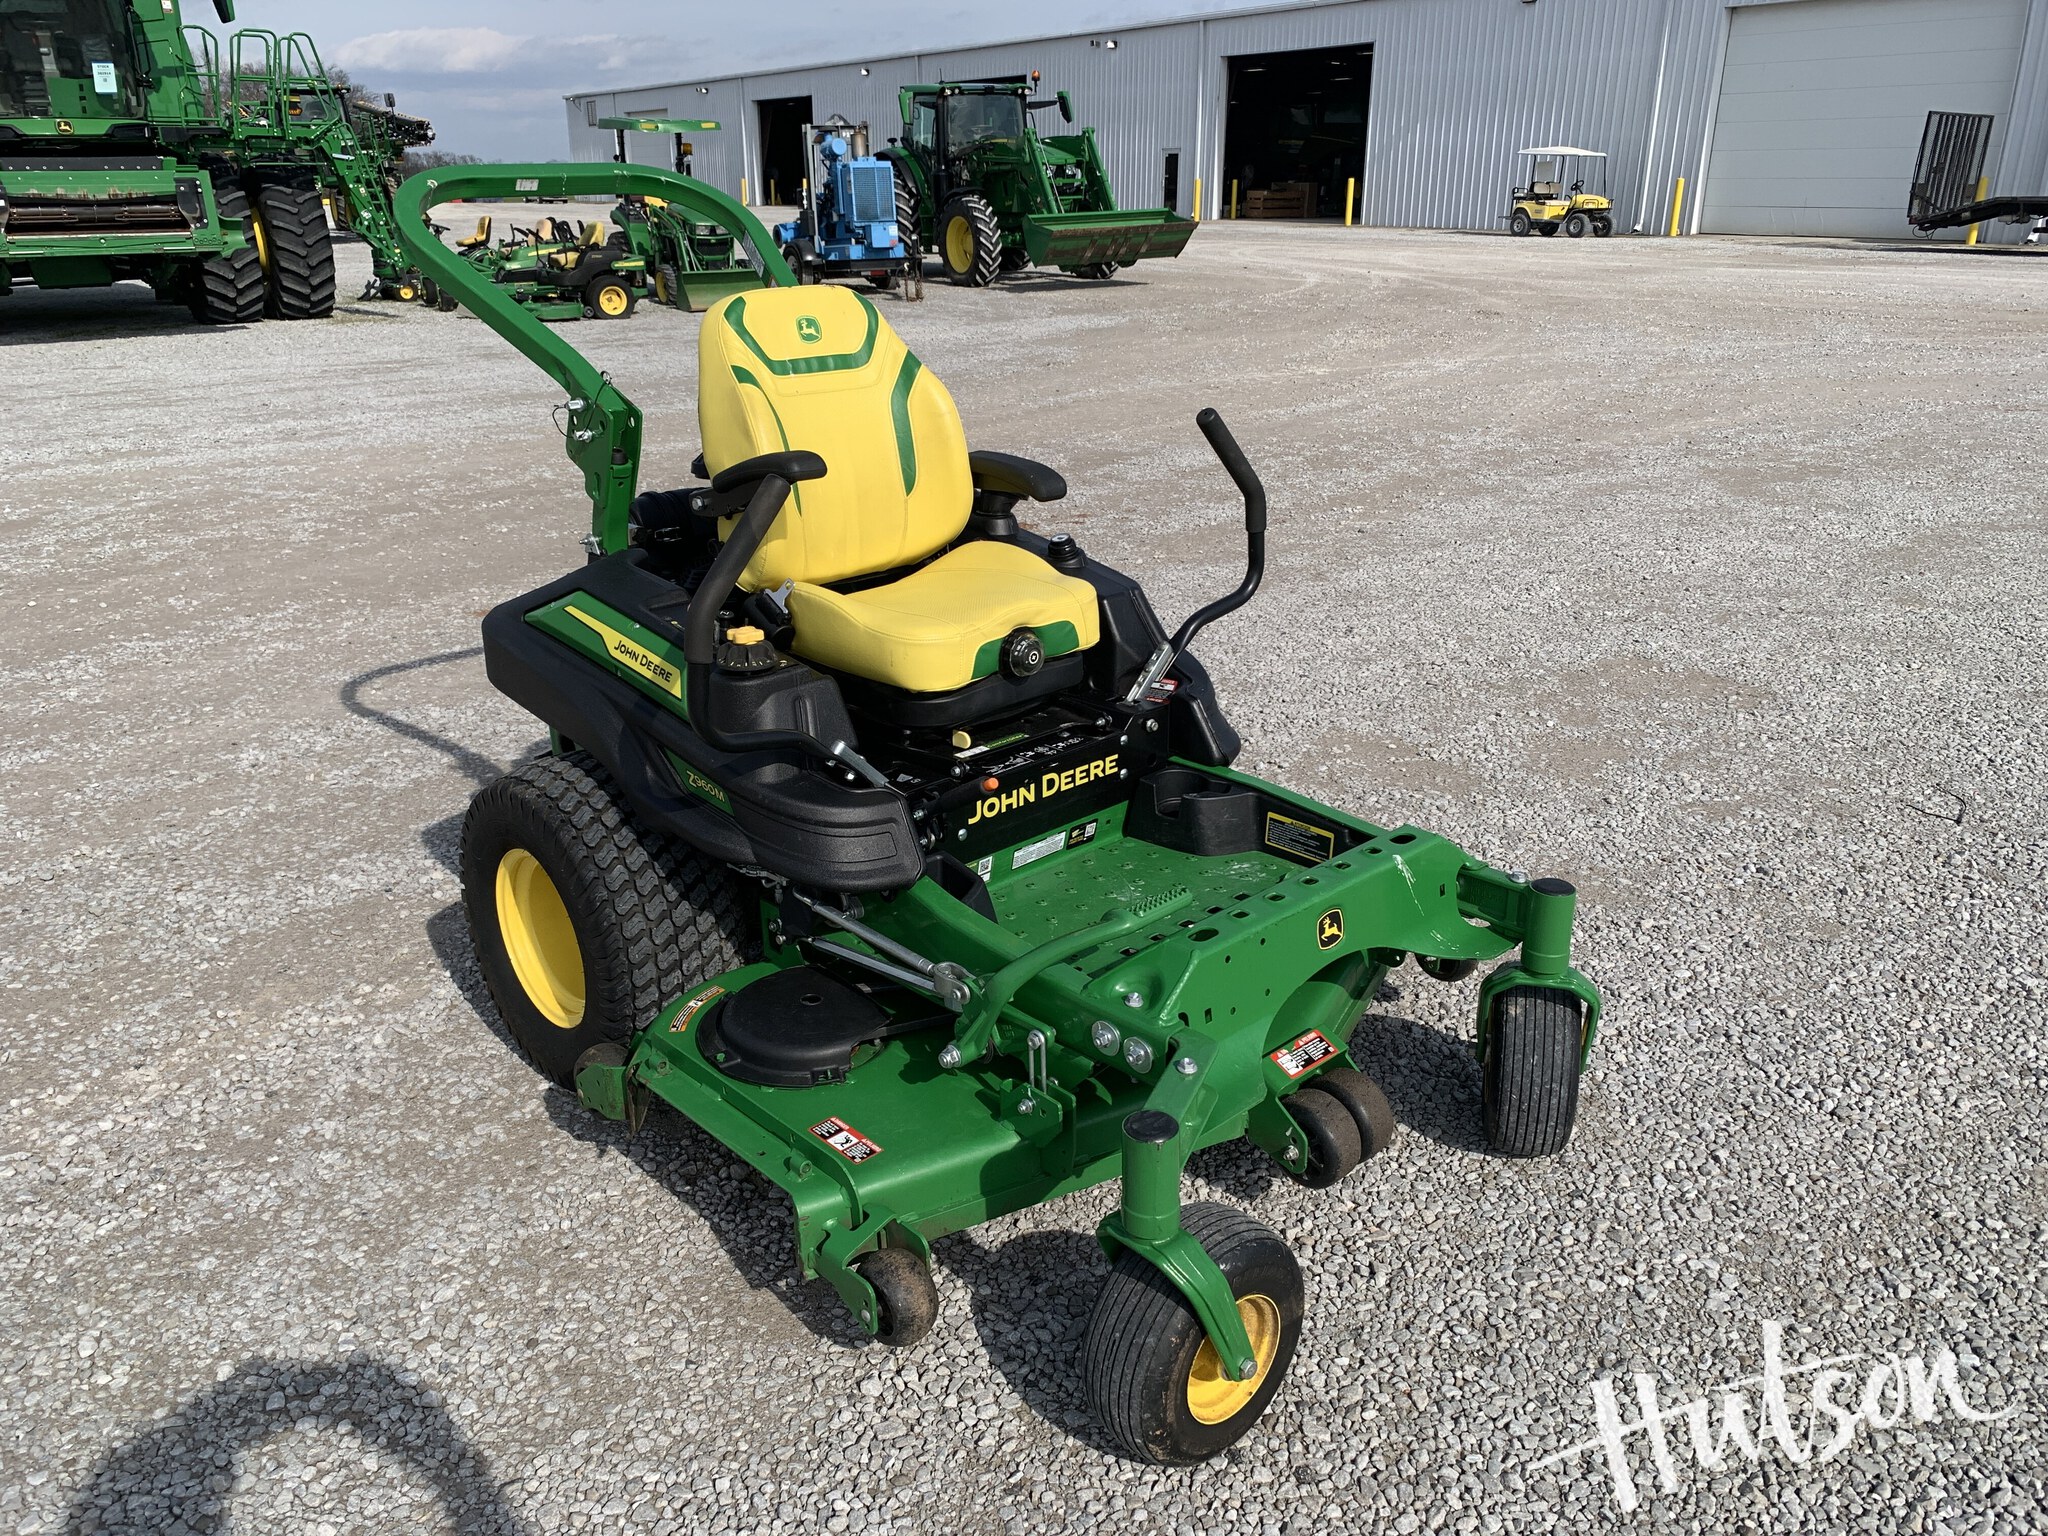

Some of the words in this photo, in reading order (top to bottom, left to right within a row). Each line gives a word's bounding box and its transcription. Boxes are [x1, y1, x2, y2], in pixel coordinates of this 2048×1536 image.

[614, 640, 640, 663] JOHN
[640, 654, 673, 683] DEERE
[686, 770, 725, 802] Z960M
[968, 783, 1035, 825] JOHN
[1042, 754, 1119, 798] DEERE
